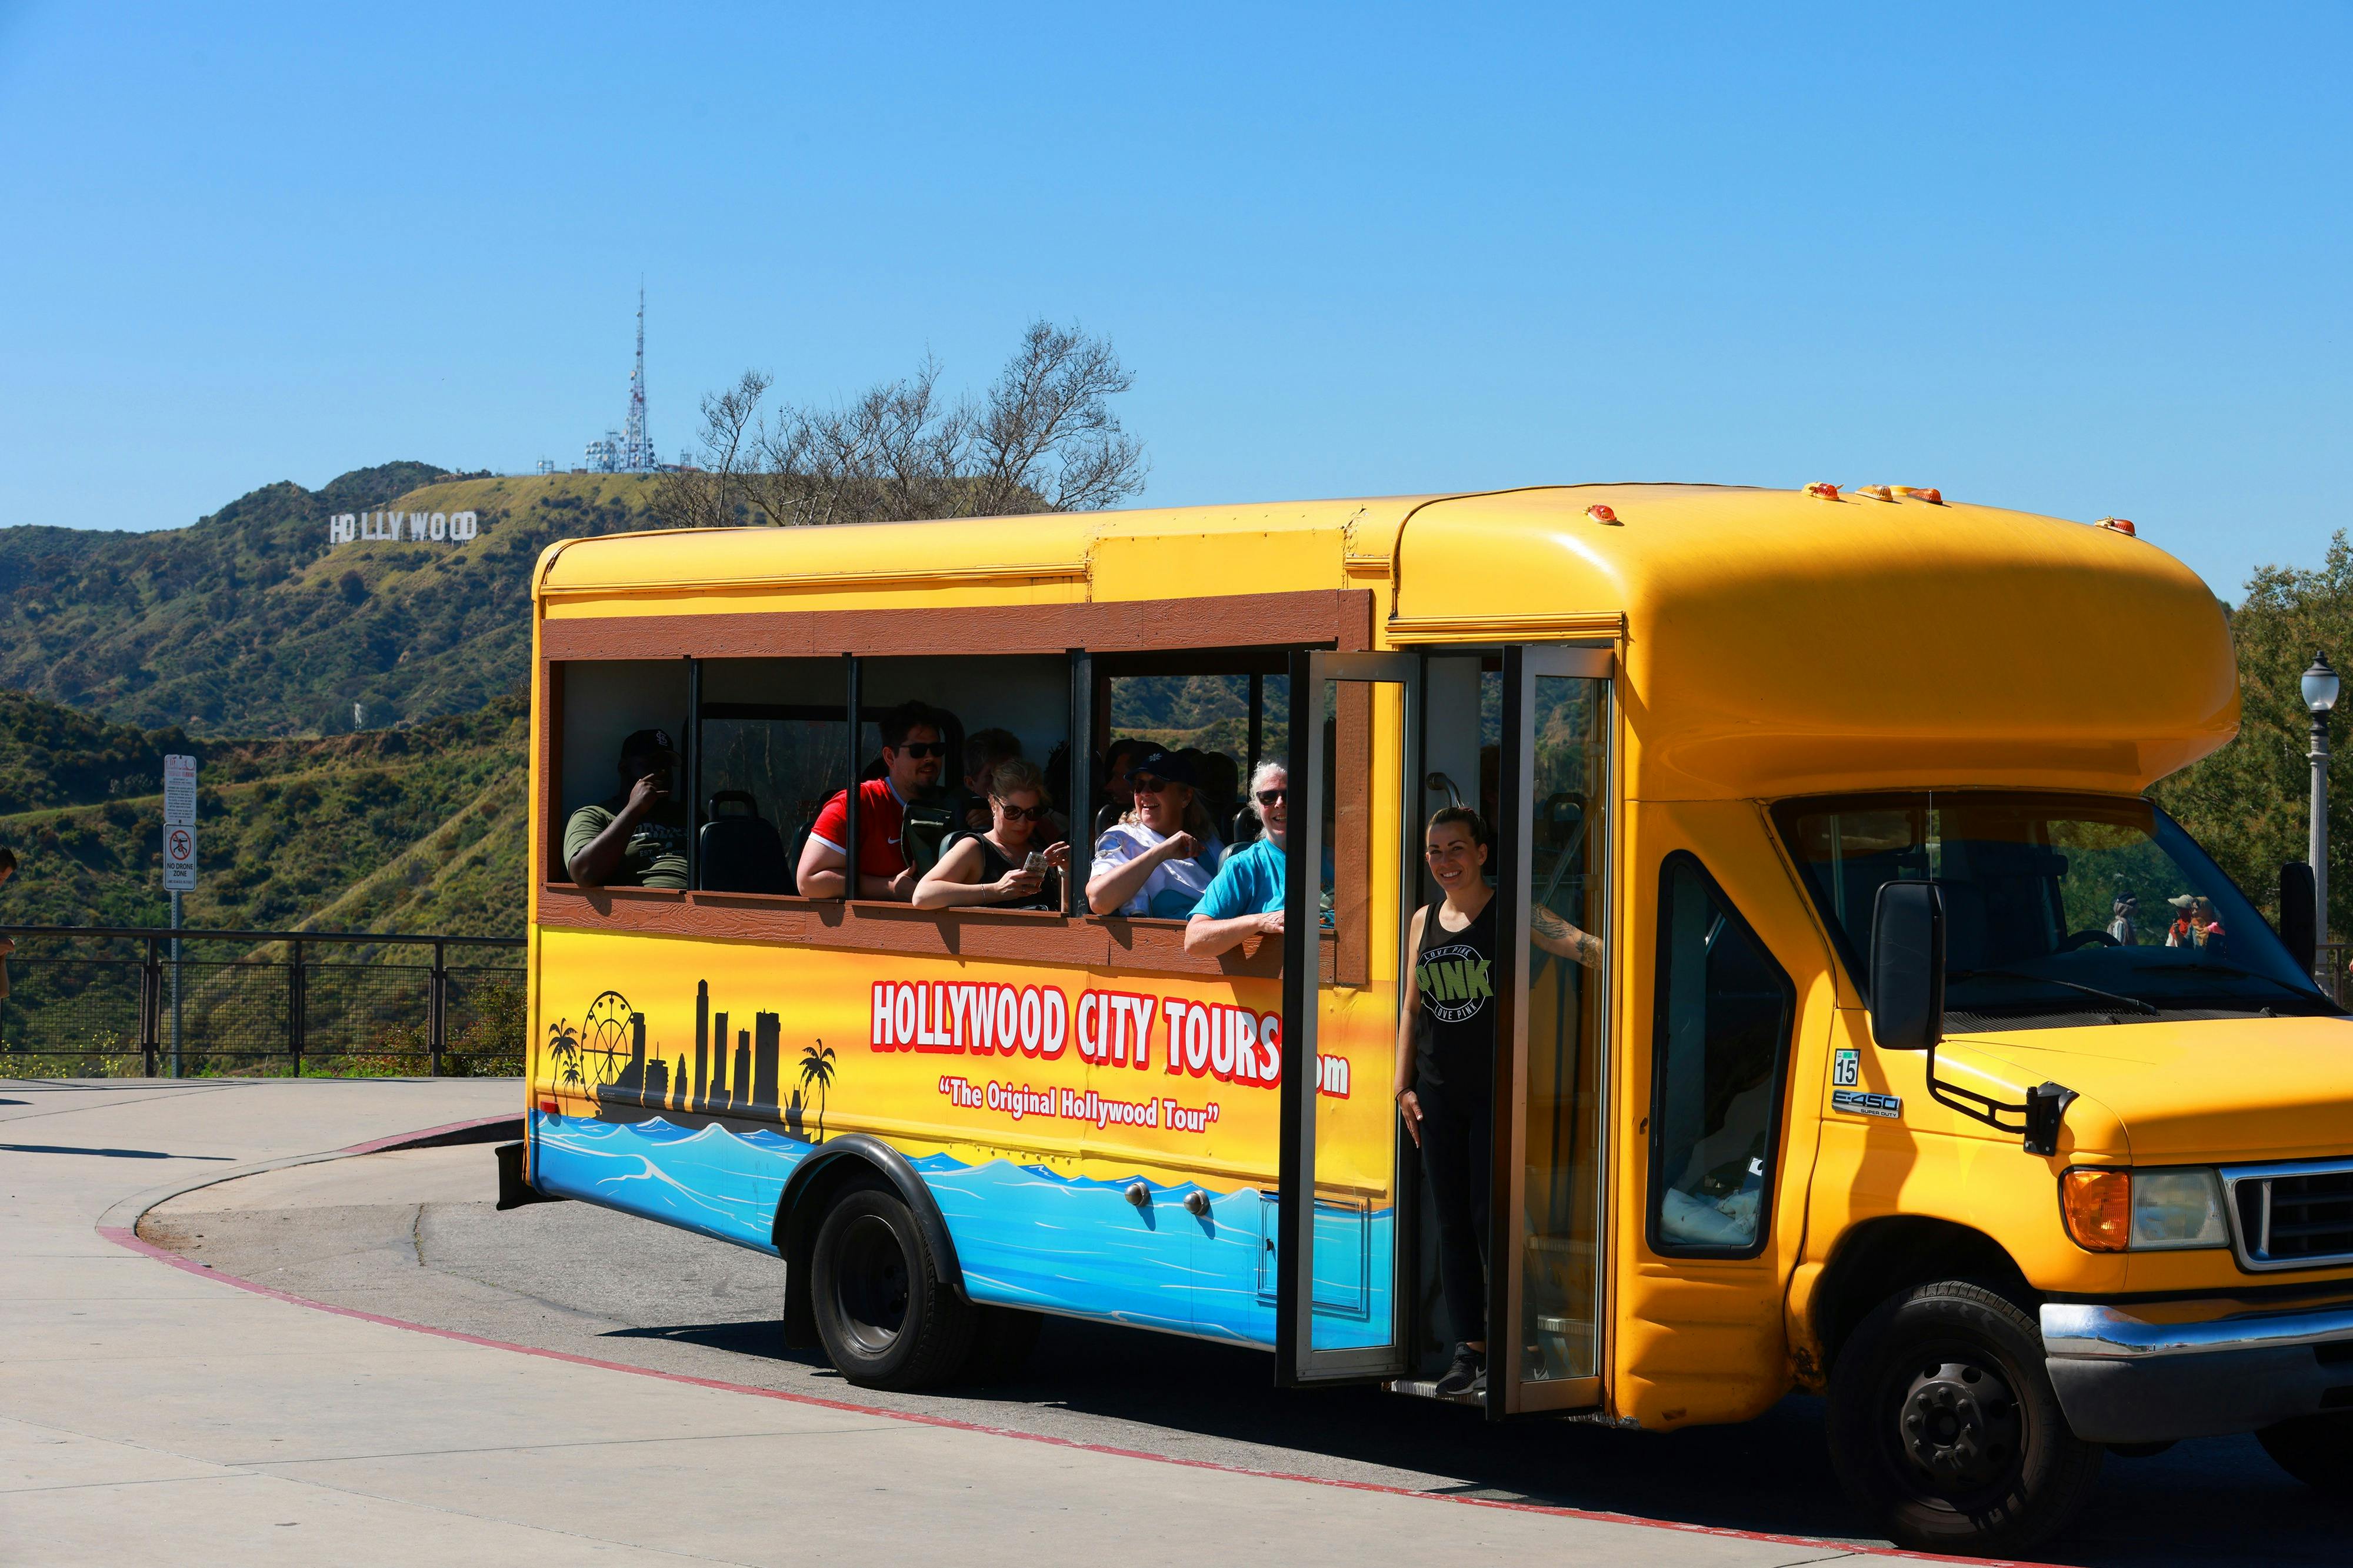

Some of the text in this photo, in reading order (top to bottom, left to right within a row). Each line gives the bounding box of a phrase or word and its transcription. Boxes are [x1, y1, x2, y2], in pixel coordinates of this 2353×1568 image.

[330, 511, 477, 544] HOLLYWOOD
[1424, 946, 1471, 960] LOVE PINK
[1415, 959, 1494, 1002] PINK
[872, 984, 1066, 1053] HOLLYWOOD
[1078, 992, 1154, 1062] CITY
[1434, 1002, 1477, 1020] LOVE PINK
[1837, 1059, 1857, 1083] 15
[939, 1077, 1218, 1131] “The Original Hollywood Tour”
